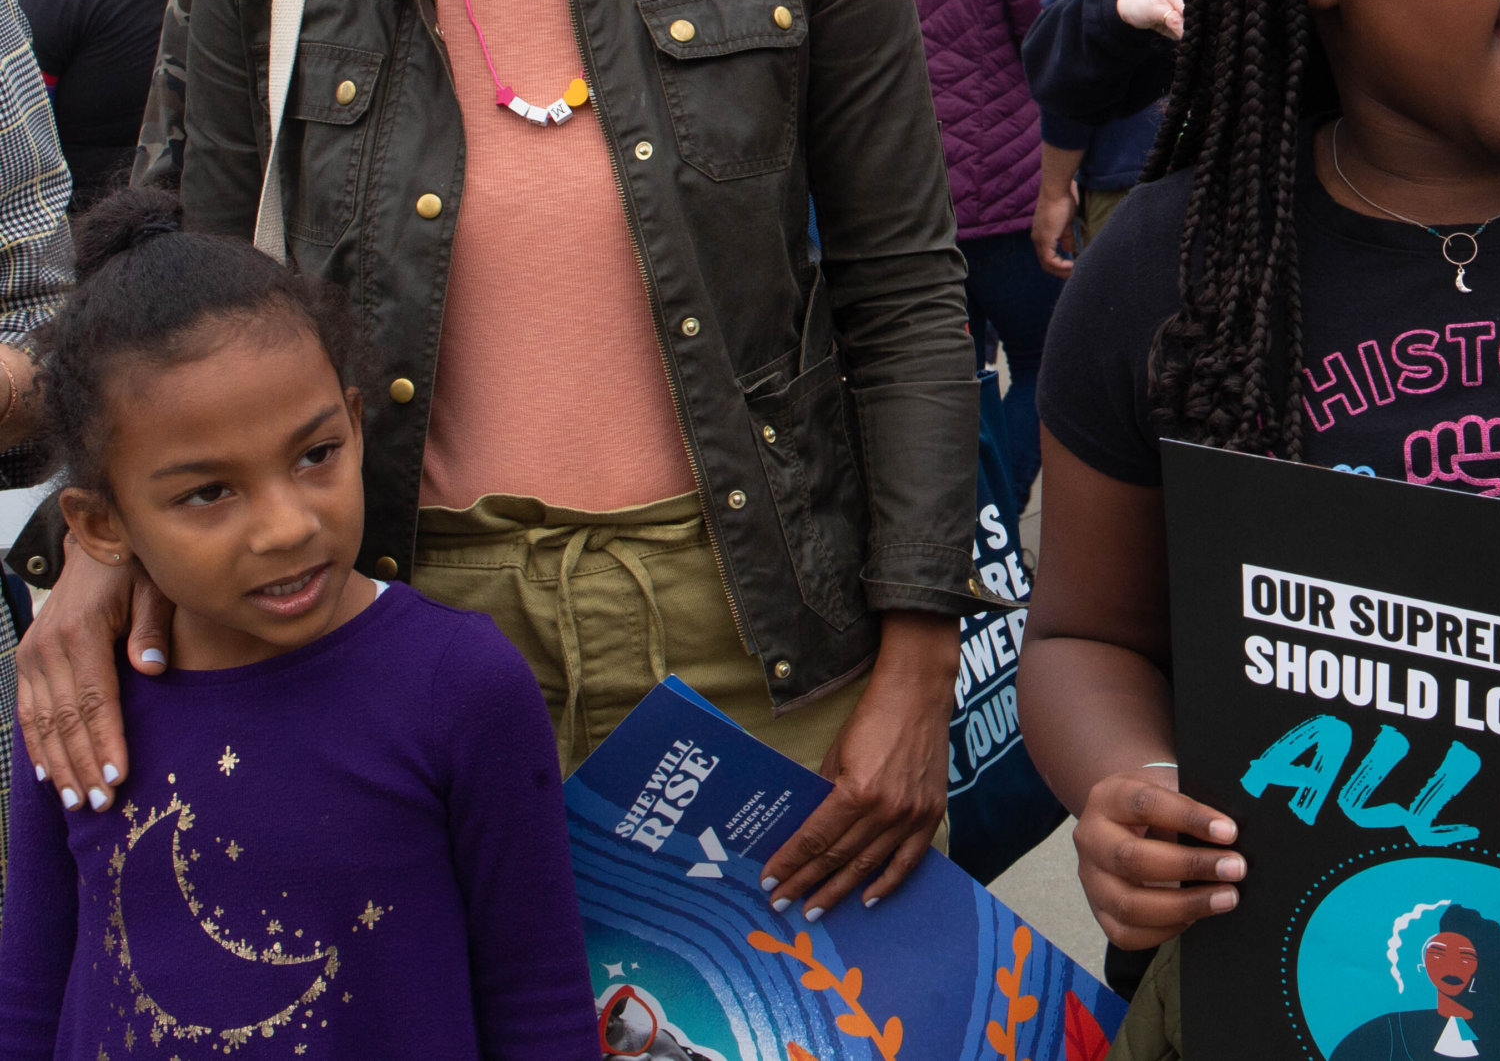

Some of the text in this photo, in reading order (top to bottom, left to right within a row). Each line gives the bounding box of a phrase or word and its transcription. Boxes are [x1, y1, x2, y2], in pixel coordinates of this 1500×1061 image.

[1250, 573, 1336, 630] OUR
[1244, 635, 1439, 721] SHOULD
[615, 739, 695, 838] SHE WILL
[631, 747, 720, 853] RISE
[725, 790, 766, 830] NATIONAL
[743, 790, 793, 840] LAW CENTER
[1240, 713, 1482, 848] ALL
[727, 803, 766, 841] WOMEN'S
